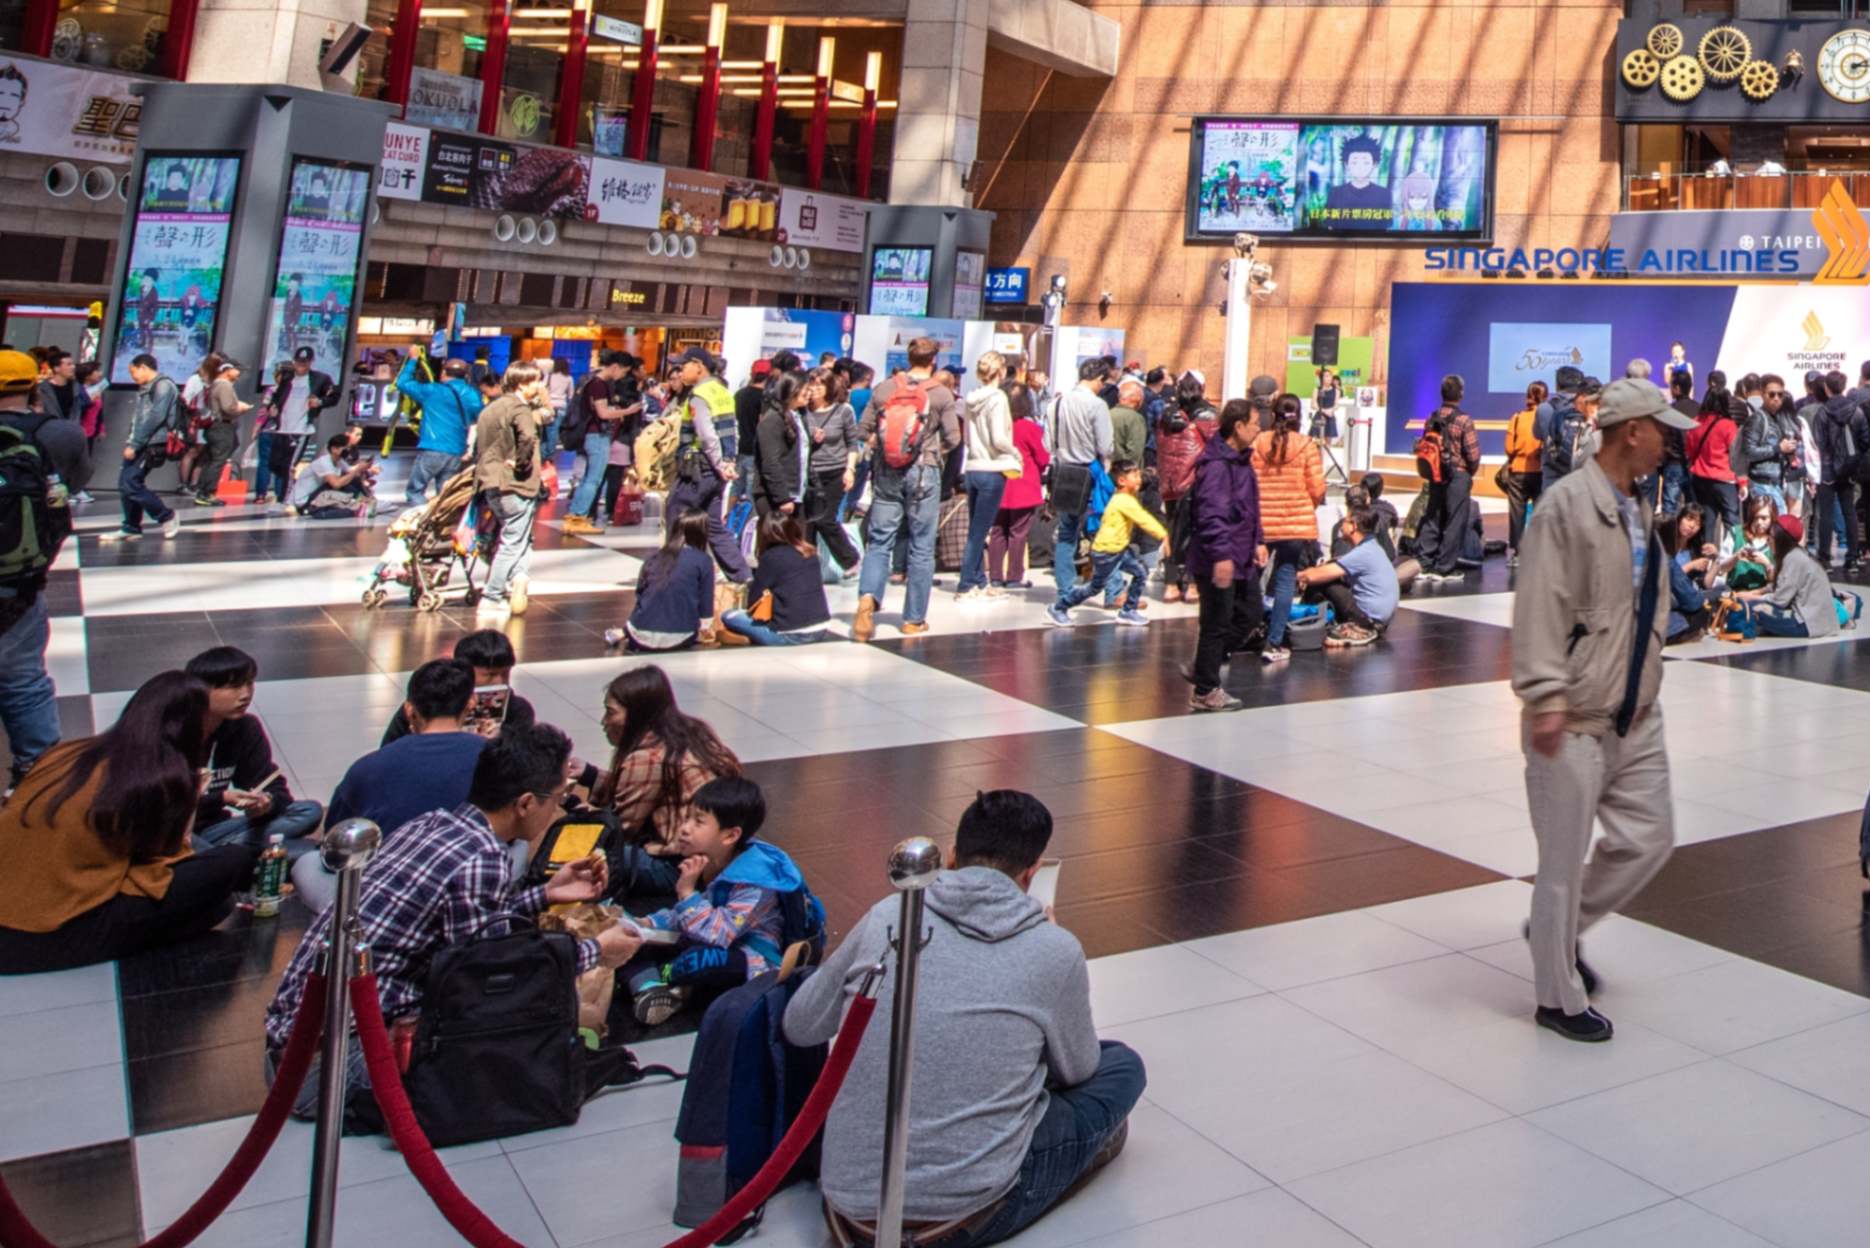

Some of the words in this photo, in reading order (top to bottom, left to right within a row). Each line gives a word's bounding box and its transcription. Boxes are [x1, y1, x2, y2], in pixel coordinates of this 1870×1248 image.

[1761, 235, 1821, 250] TAIPEI
[1424, 247, 1624, 272] SINGAPORE
[1637, 249, 1800, 273] AIRLINES
[612, 288, 645, 304] Breeze
[1787, 352, 1847, 361] SINGAPORE
[1793, 362, 1841, 370] AIRLINES
